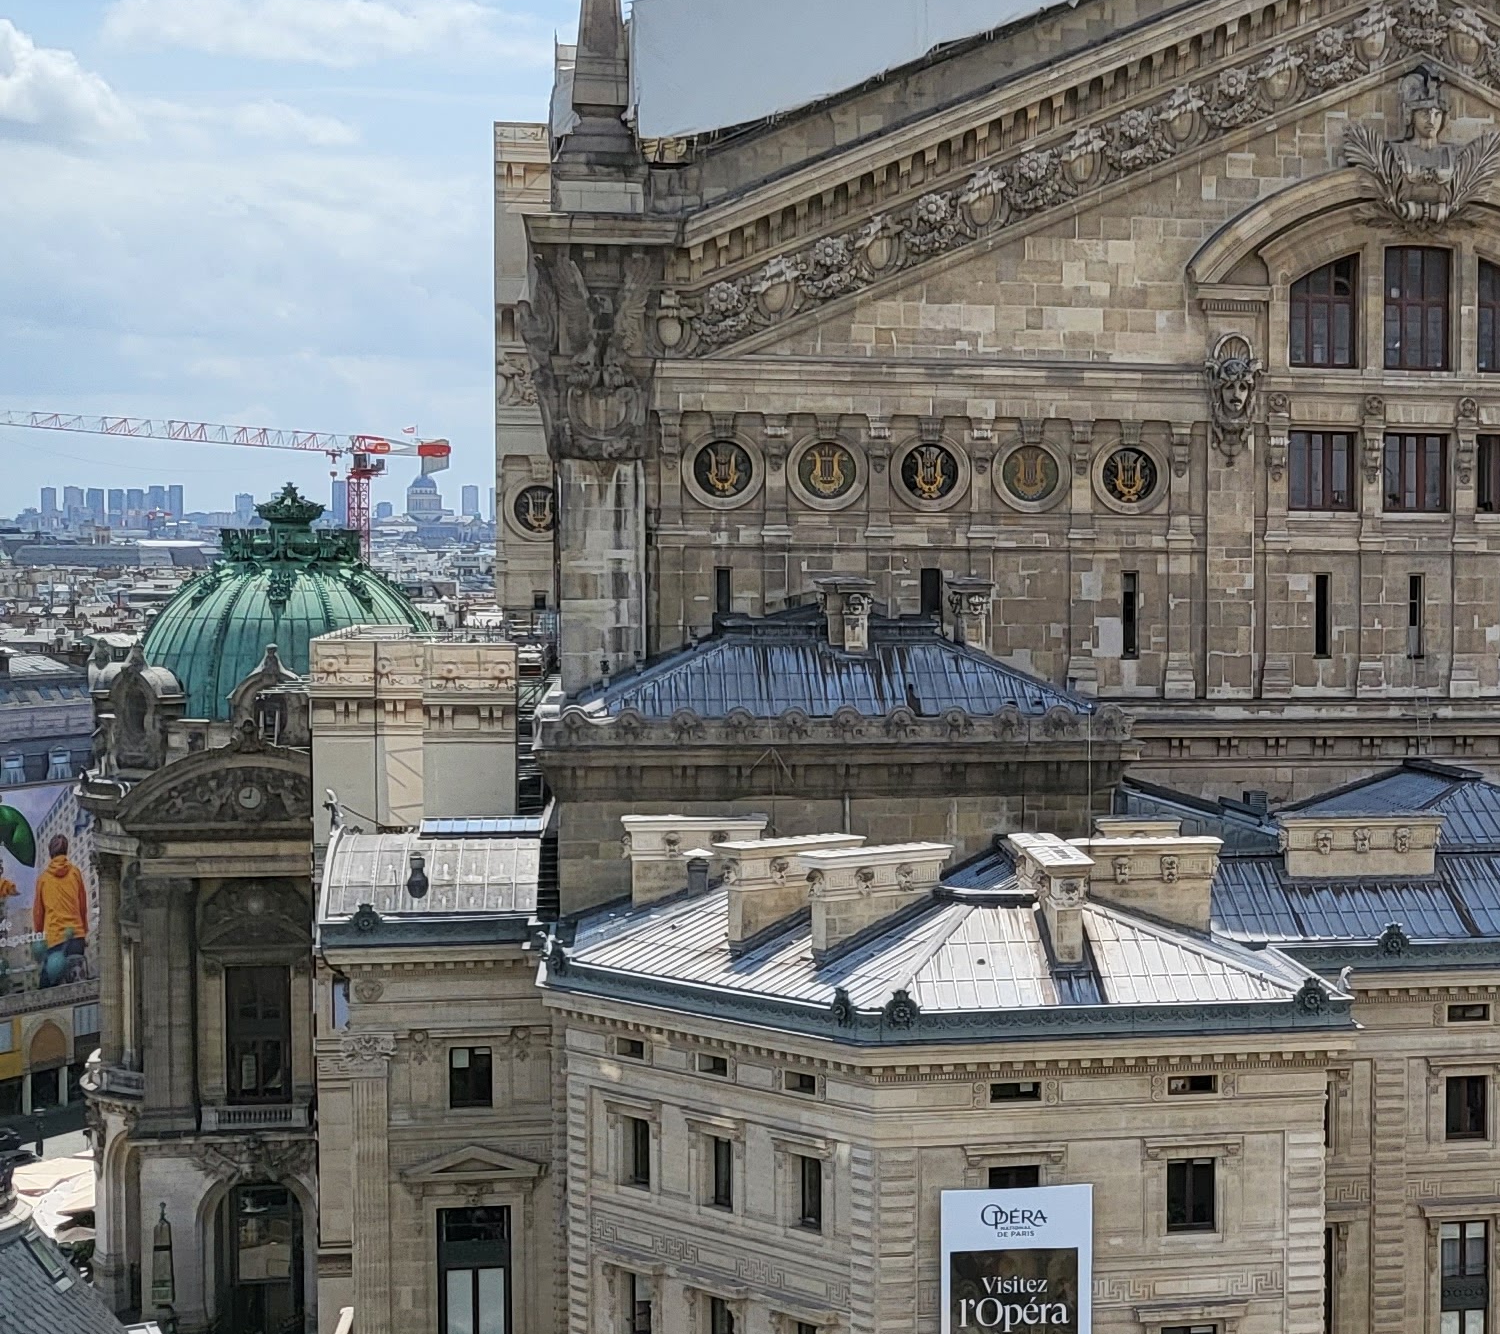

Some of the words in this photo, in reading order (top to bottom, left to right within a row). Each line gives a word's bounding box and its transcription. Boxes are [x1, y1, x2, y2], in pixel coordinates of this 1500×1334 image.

[981, 1203, 1048, 1230] OPÉRA
[981, 1275, 1048, 1294] Visitez
[959, 1296, 1070, 1333] l'Opéra
